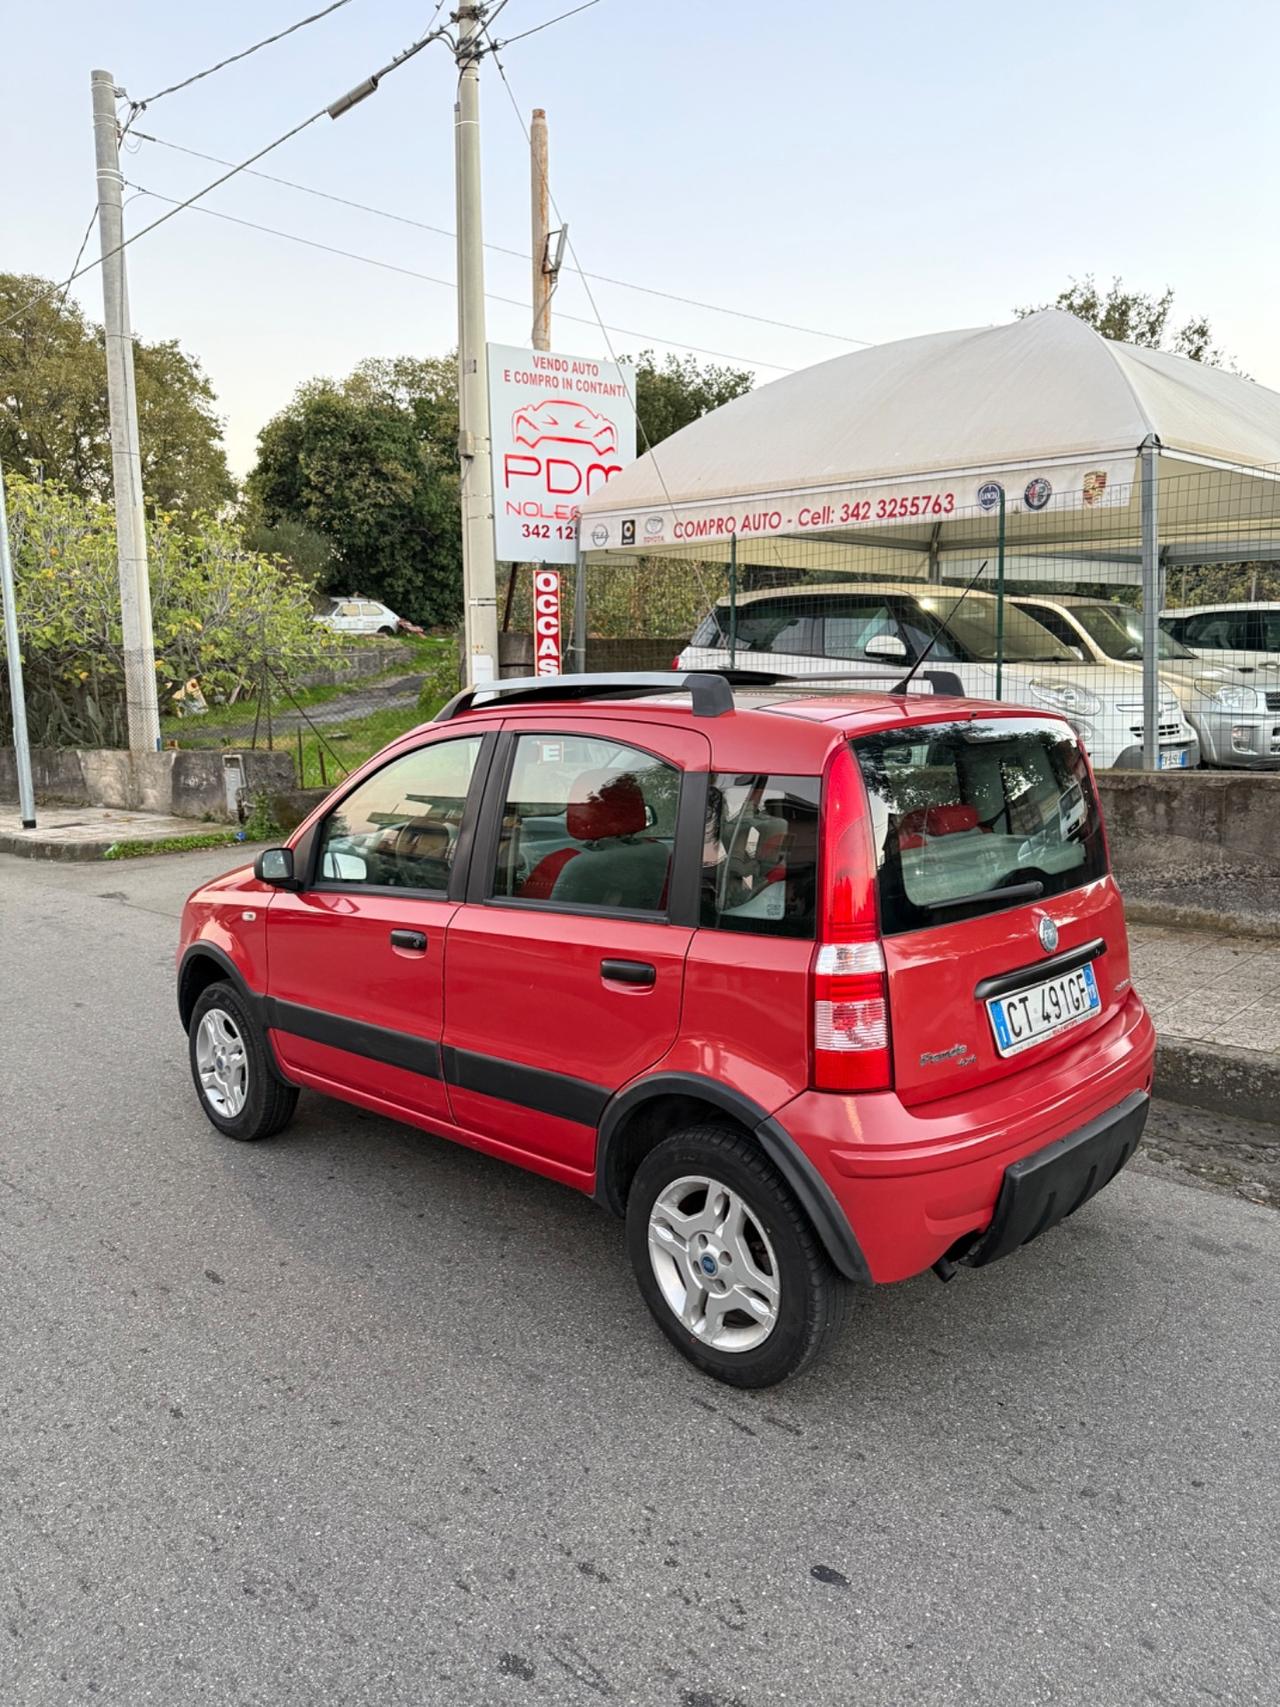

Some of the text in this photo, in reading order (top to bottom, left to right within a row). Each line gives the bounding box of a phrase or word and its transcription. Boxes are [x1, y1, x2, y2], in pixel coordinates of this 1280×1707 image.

[532, 355, 599, 376] VENDO AUTO
[503, 369, 626, 397] E COMPRO IN CONTANTI
[673, 515, 737, 539] COMPRO
[740, 511, 782, 532] AUTO
[798, 504, 835, 527] Cell:
[840, 502, 871, 522] 342
[876, 493, 955, 519] 3255763
[521, 523, 550, 538] 342
[1007, 996, 1032, 1037] CT
[1042, 973, 1085, 1023] 491GF
